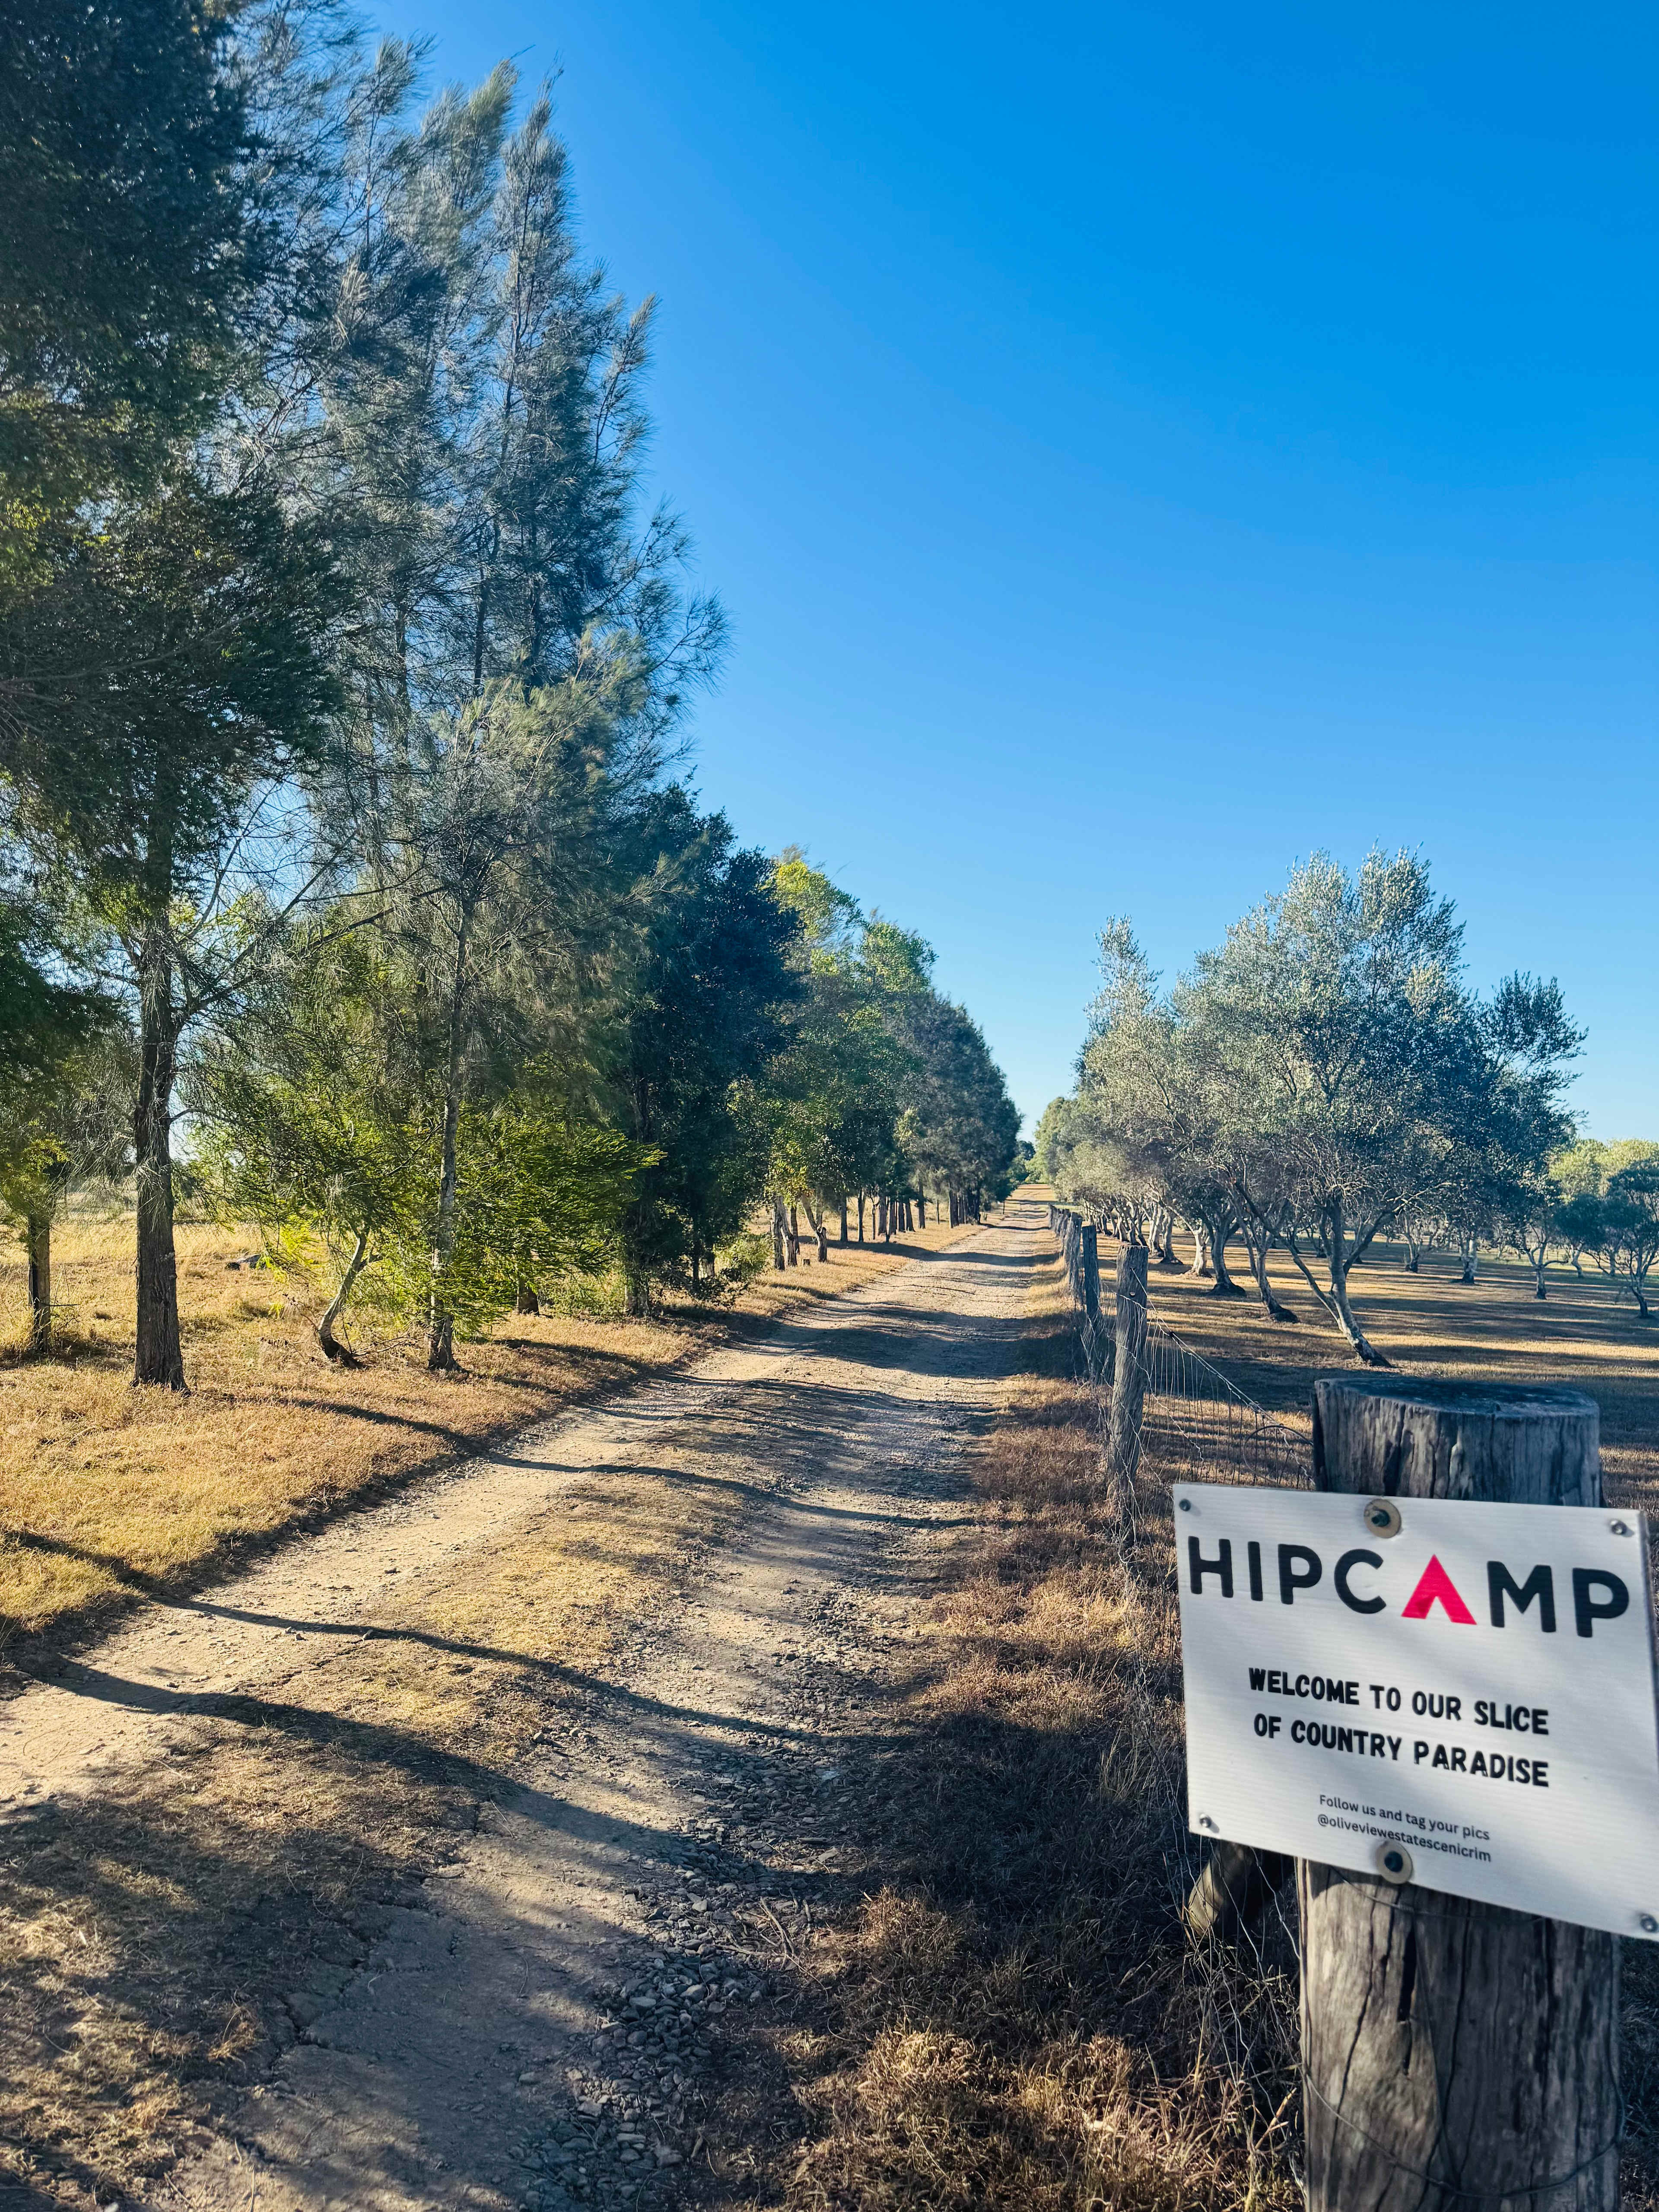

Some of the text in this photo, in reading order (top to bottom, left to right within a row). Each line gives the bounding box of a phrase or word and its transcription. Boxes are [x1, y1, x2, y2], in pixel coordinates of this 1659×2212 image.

[1188, 1536, 1630, 1638] HIPCAMP
[1248, 1667, 1549, 1735] WELCOME TO OUR SLICE
[1253, 1713, 1549, 1787] OF COUNTRY PARADISE
[1318, 1815, 1491, 1862] @oliveviewestatescenicrim
[1319, 1794, 1490, 1840] Follow us and tag your pics
